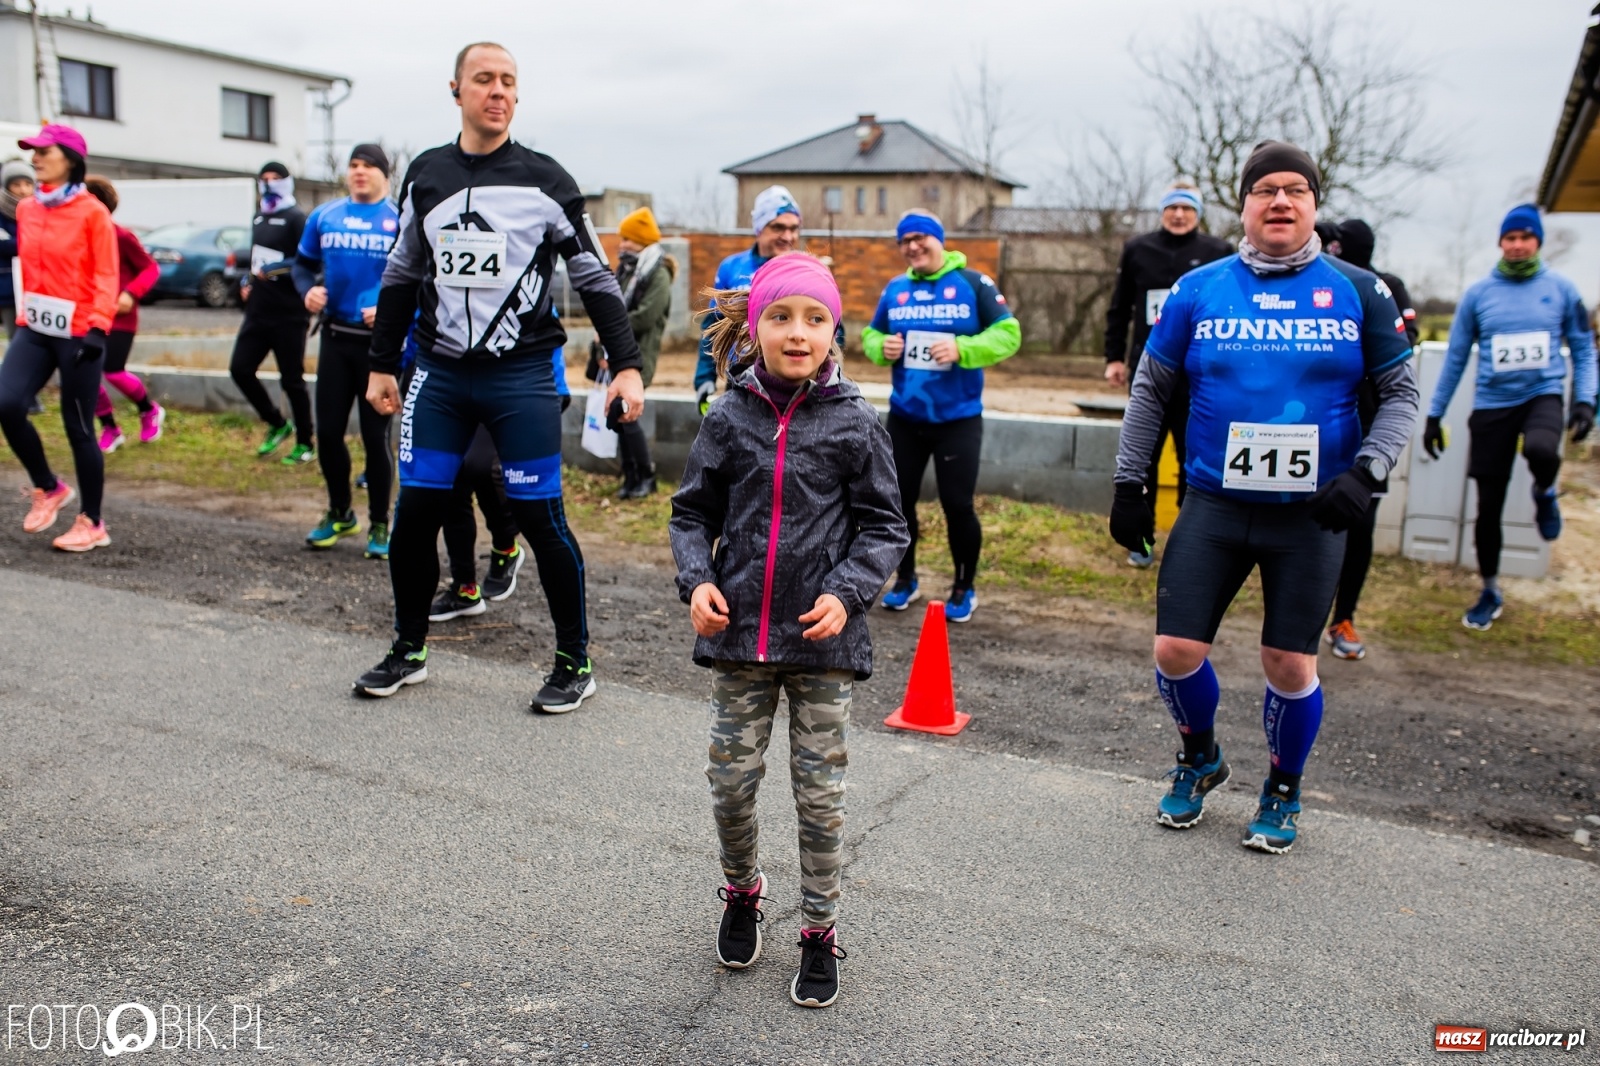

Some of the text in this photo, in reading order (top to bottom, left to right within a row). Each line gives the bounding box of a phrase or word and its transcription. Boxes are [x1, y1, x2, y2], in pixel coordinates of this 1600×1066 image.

[441, 251, 501, 277] 324
[27, 307, 67, 330] 360
[887, 303, 971, 320] RUNNERS
[1194, 318, 1360, 342] RUNNERS
[908, 346, 934, 362] 45
[1295, 343, 1334, 352] TEAM
[1498, 346, 1544, 363] 233
[400, 366, 429, 463] RUNNERS
[1228, 447, 1311, 479] 415
